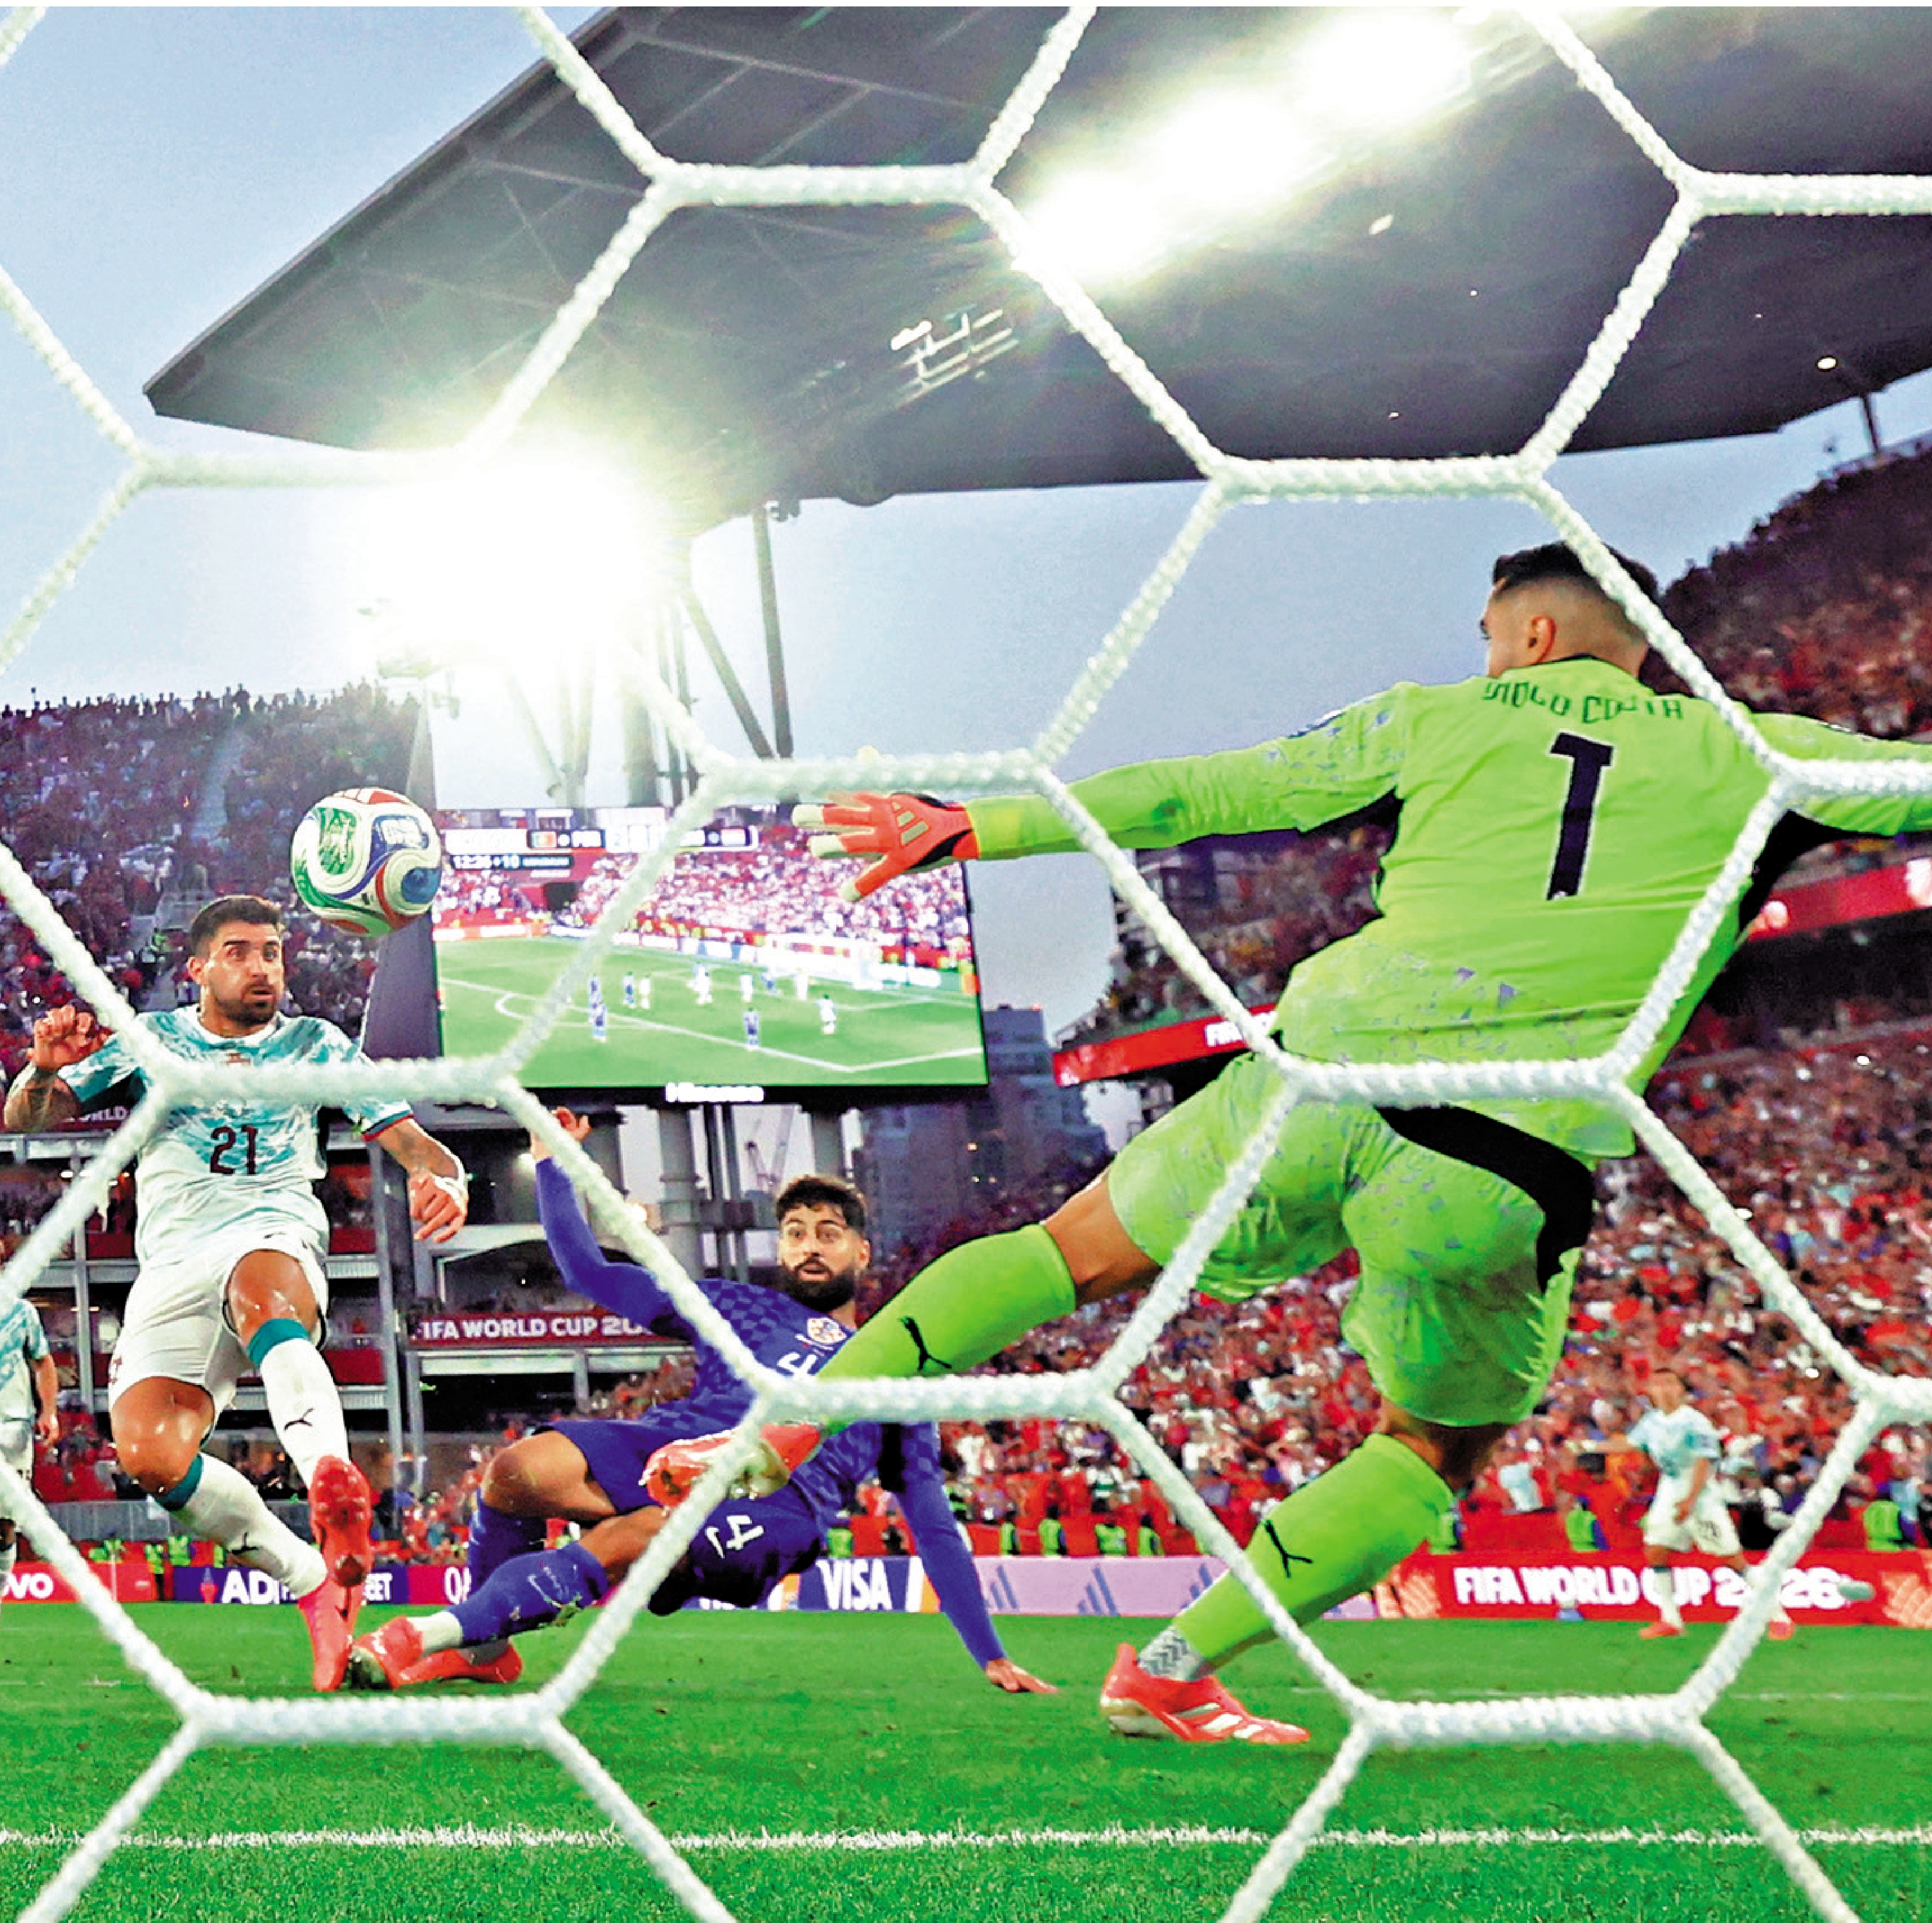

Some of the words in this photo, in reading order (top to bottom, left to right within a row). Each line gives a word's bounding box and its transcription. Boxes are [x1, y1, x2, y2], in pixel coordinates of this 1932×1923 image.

[1547, 731, 1615, 900] 1
[210, 1124, 257, 1175] 21
[460, 1319, 547, 1338] WORLD
[551, 1316, 598, 1337] CUP
[815, 1558, 893, 1611] VISA
[1453, 1566, 1525, 1604] FIFA
[1518, 1565, 1640, 1605] WORLD
